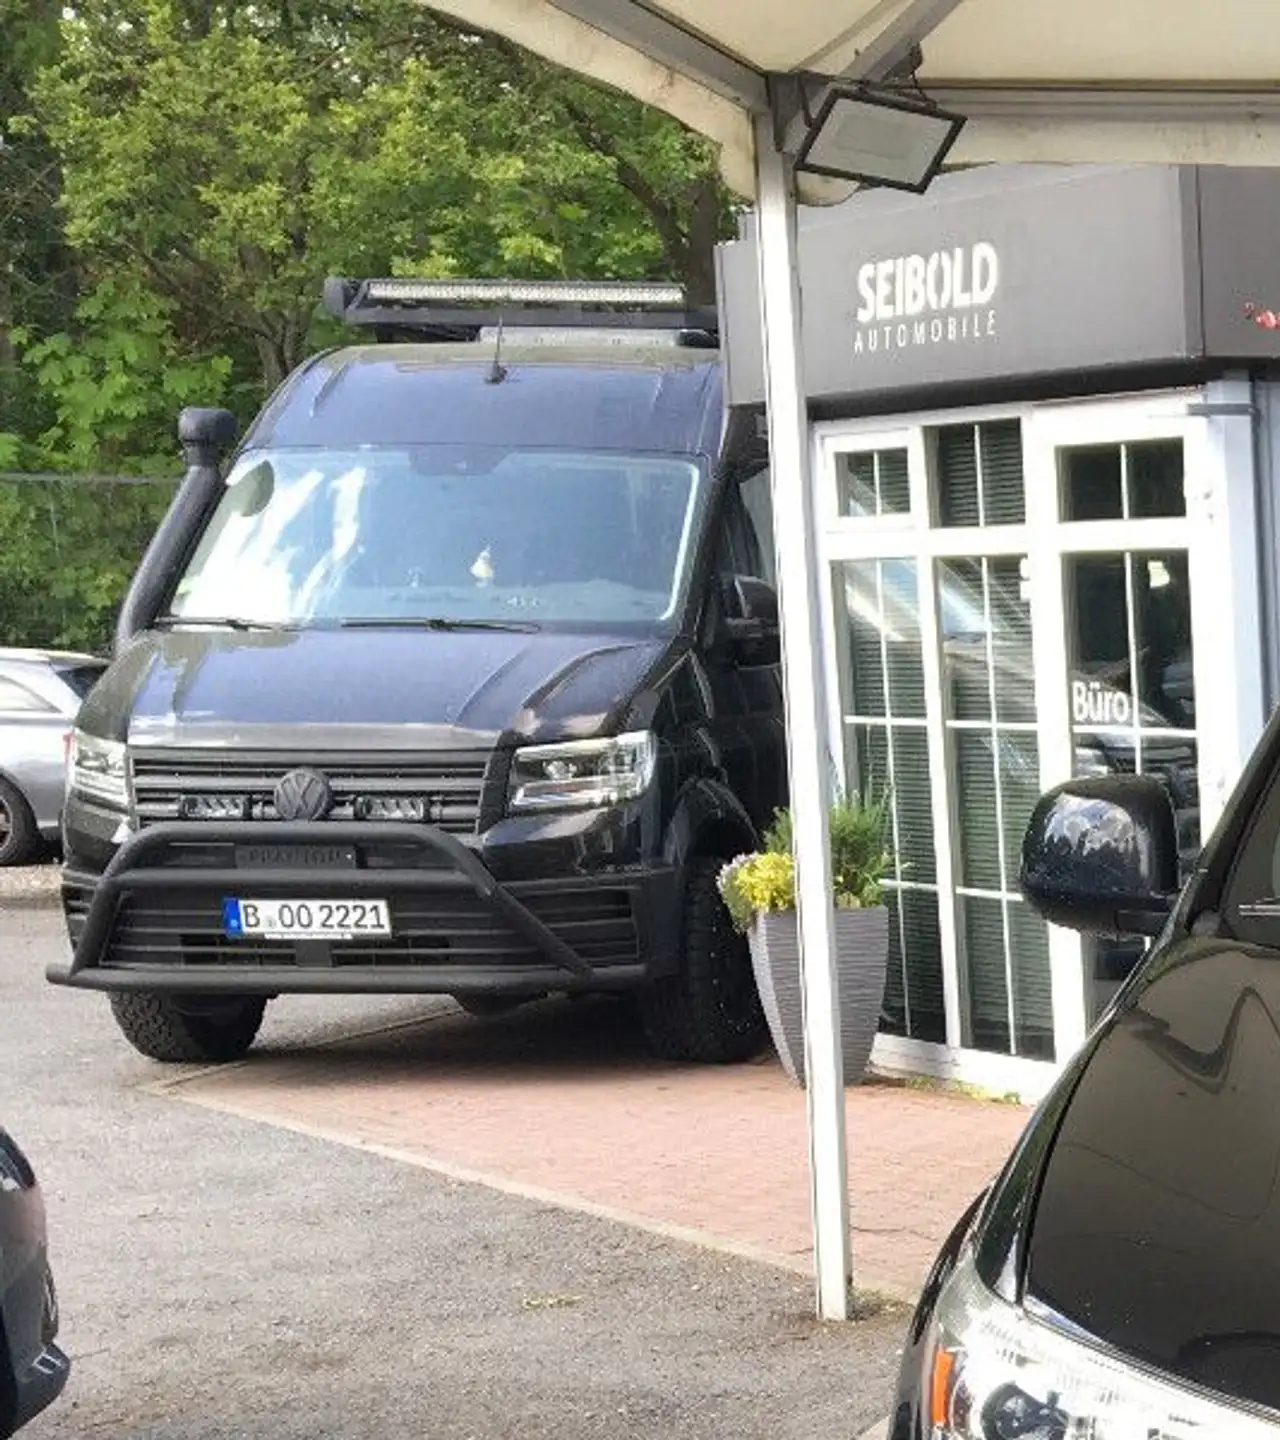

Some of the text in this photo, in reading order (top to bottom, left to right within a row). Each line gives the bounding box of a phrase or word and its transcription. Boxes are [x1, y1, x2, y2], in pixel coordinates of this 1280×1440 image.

[857, 242, 998, 323] SEIBOLD
[854, 309, 997, 354] AUTOMOBILE
[1073, 681, 1129, 722] Büro
[242, 903, 260, 928] B
[319, 904, 385, 929] 2221
